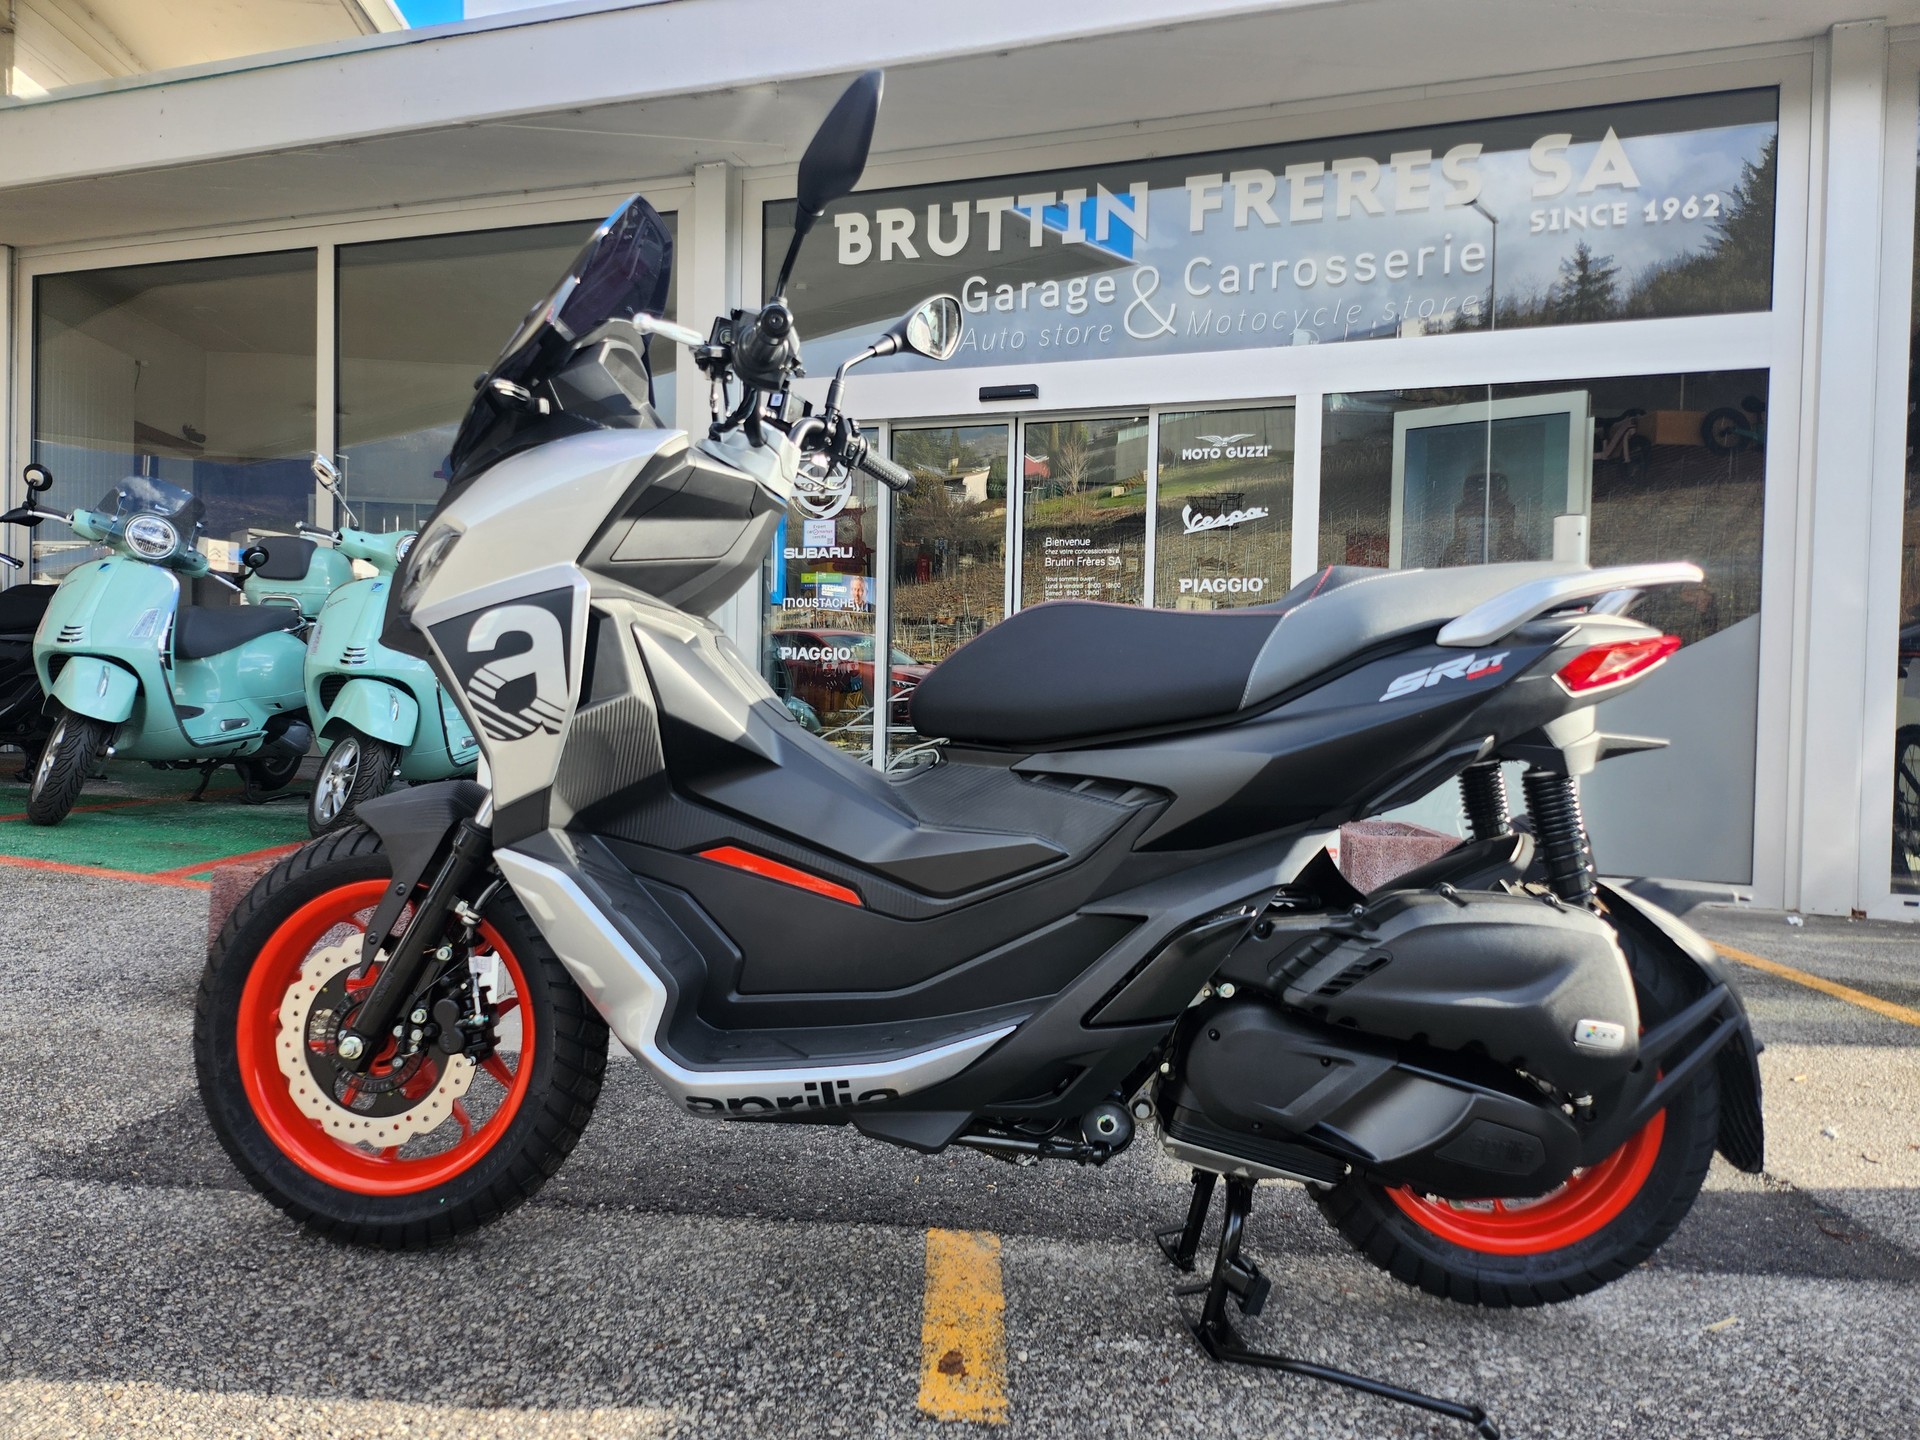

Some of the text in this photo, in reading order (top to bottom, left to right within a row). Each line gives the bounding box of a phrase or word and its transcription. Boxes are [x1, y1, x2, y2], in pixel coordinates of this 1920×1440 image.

[834, 126, 1641, 266] BRUTTIN FRERES SA
[1530, 193, 1721, 232] SINCE 1962
[962, 233, 1486, 340] Garage & Carrosserie
[1186, 295, 1479, 336] Motocycle store
[959, 323, 1113, 352] Auto store
[1182, 445, 1269, 460] MOTO GUZZI
[1182, 504, 1269, 535] Vespa
[1045, 537, 1091, 546] Bienvenue
[783, 547, 853, 559] SUBARU
[1045, 556, 1121, 567] Bruttin Frères SA
[1179, 577, 1264, 593] PIAGGIO
[782, 597, 856, 611] MOUSTACHE
[780, 646, 851, 661] PIAGGIO
